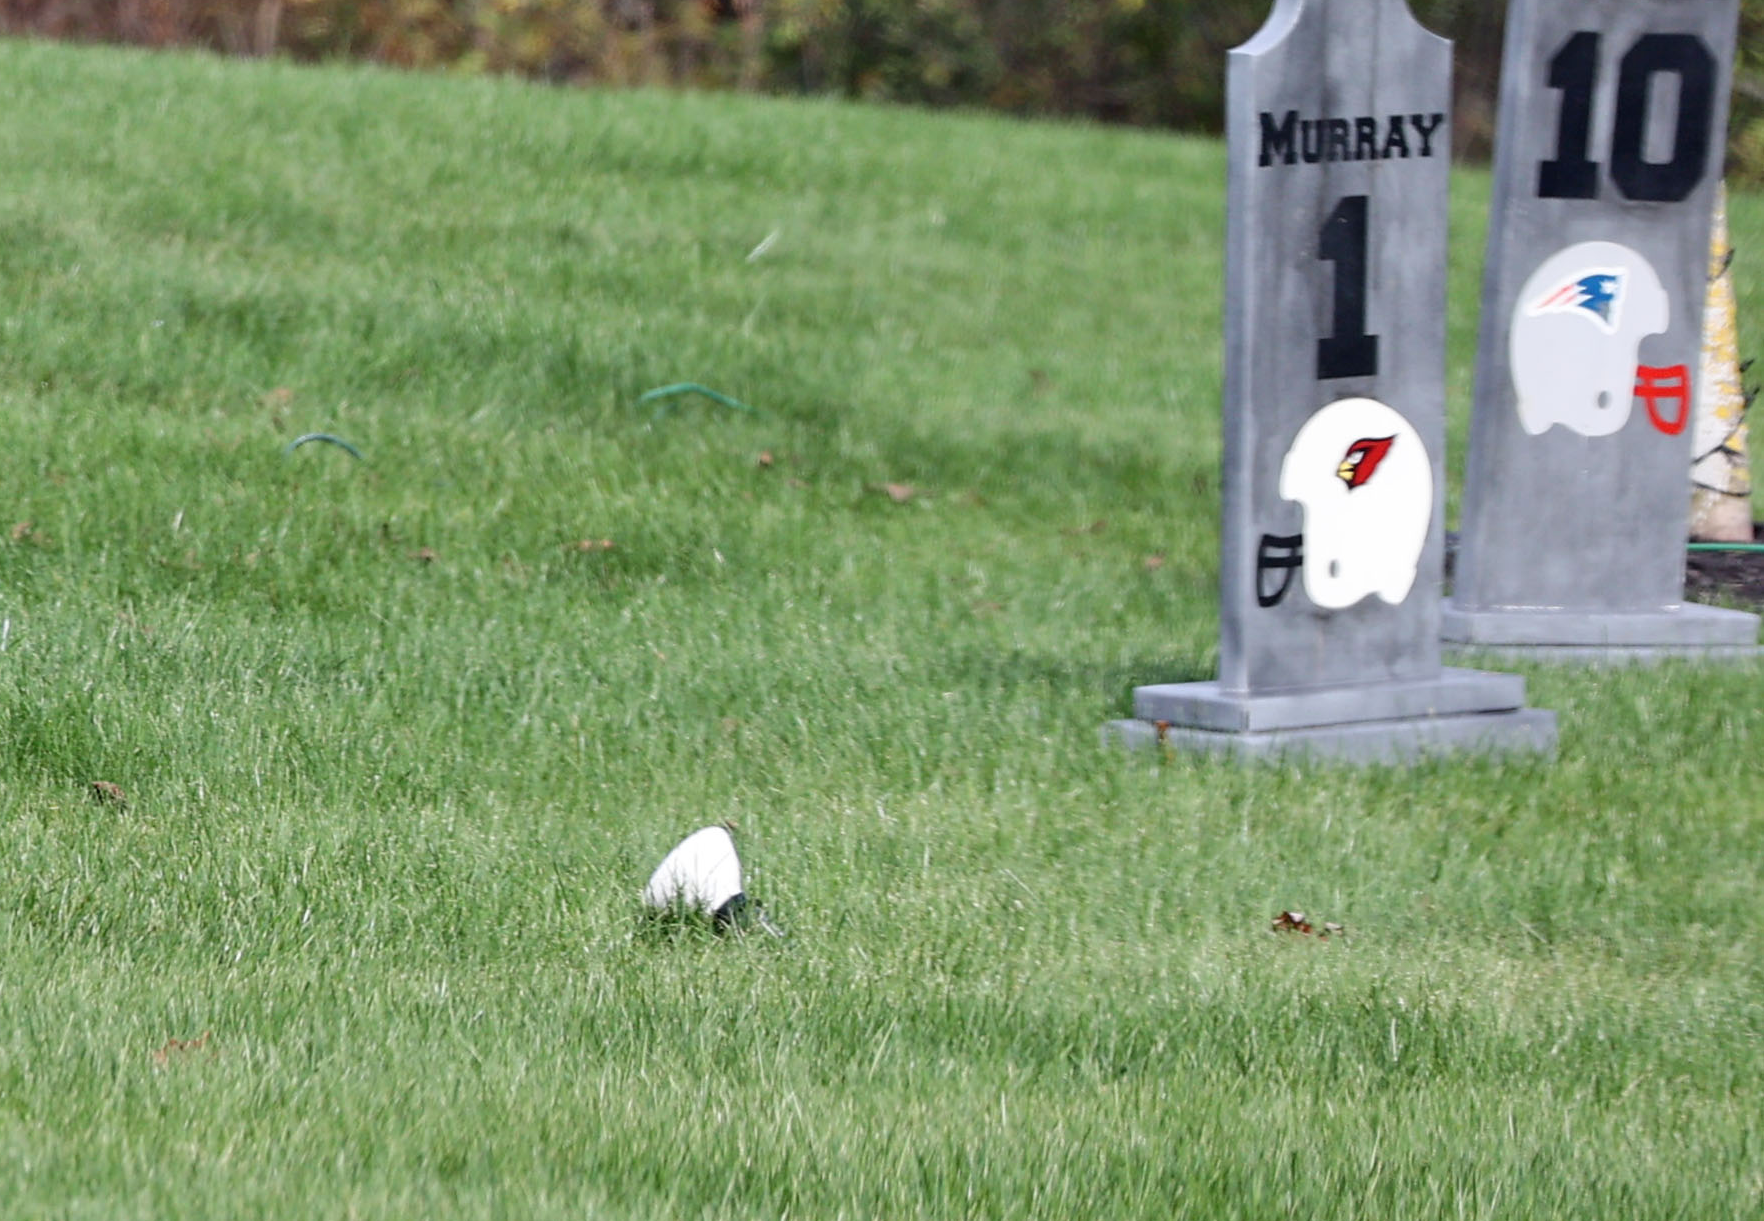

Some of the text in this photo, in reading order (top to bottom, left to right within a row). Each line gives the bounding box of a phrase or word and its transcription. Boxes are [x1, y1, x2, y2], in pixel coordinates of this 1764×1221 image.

[1258, 110, 1444, 167] MURRAY
[1537, 31, 1715, 203] 10
[1315, 195, 1379, 380] 1
